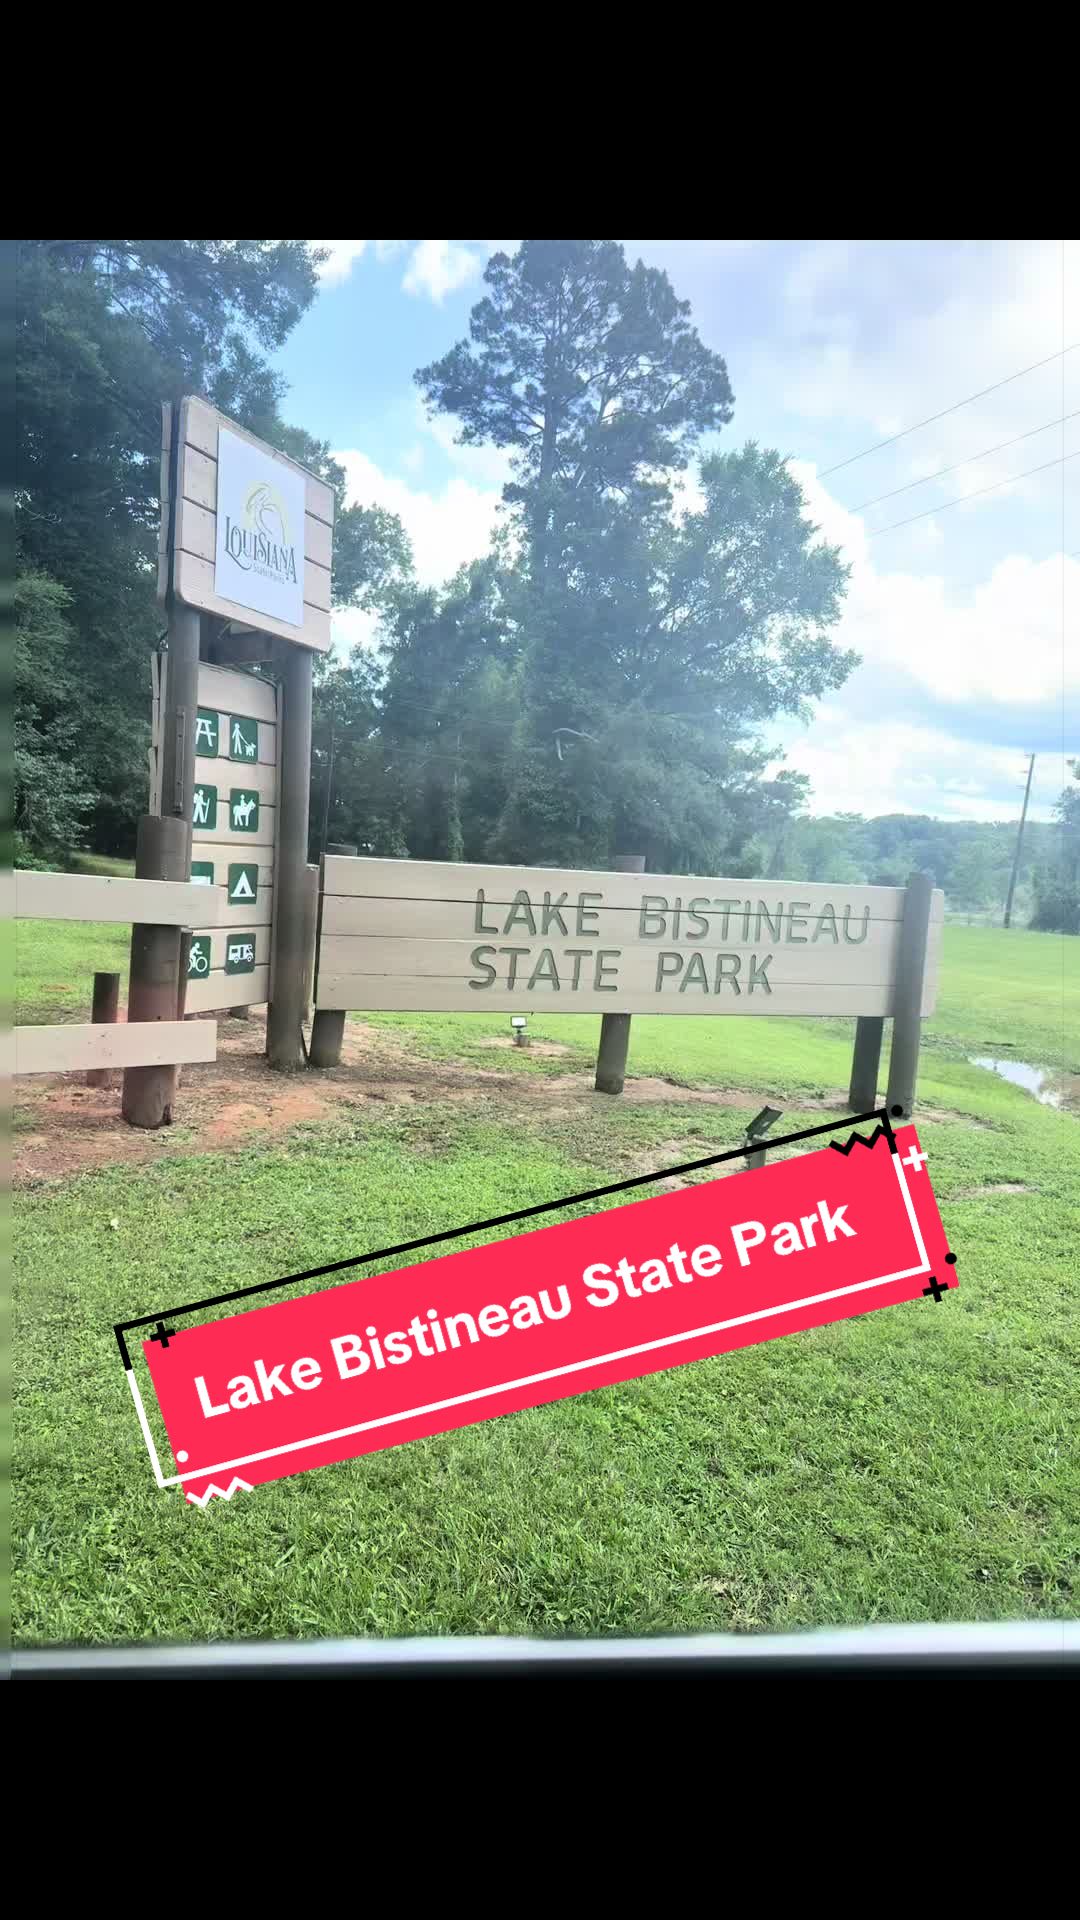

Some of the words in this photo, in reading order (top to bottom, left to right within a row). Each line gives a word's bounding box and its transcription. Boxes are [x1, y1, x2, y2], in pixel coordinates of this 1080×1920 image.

[224, 516, 297, 584] LOUISIANA
[475, 888, 603, 937] LAKE
[638, 894, 871, 945] BISTINEAU
[468, 944, 622, 993] STATE
[655, 951, 774, 996] PARK
